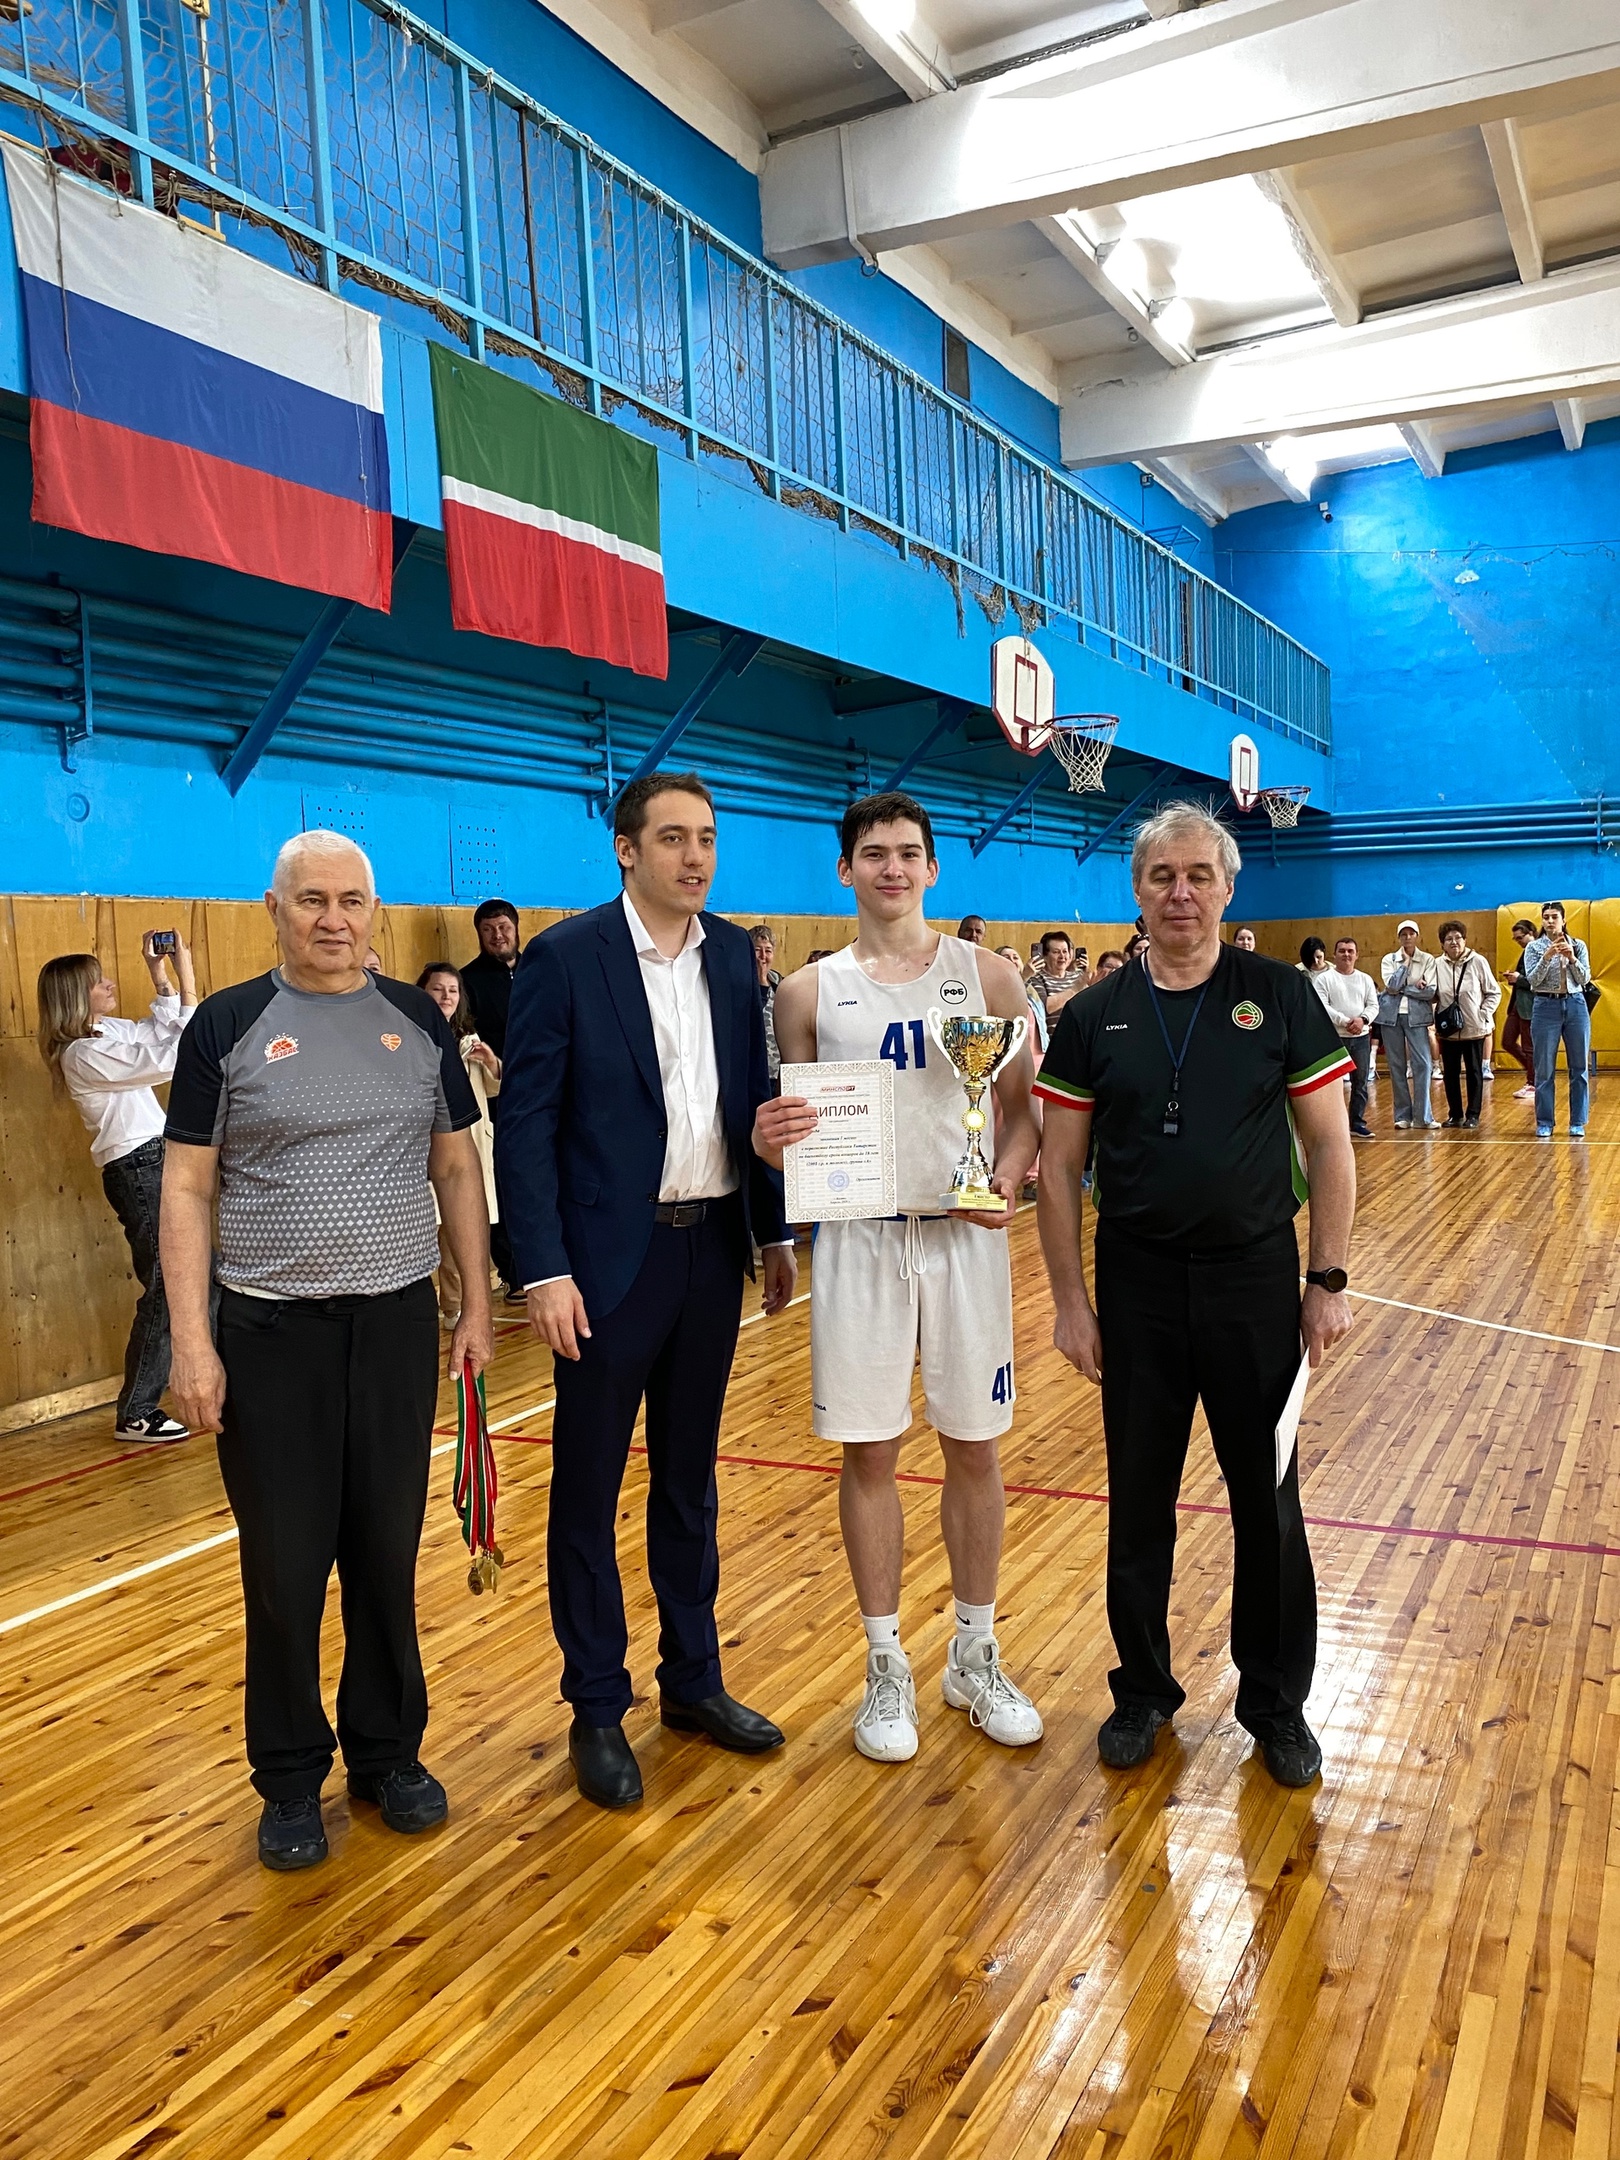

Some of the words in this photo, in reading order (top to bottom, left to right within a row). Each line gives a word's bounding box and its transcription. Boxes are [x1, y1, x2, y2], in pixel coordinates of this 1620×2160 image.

[943, 988, 964, 998] РФБ
[1105, 1023, 1128, 1031] LYKIA
[879, 1019, 927, 1070] 41
[991, 1361, 1012, 1405] 41
